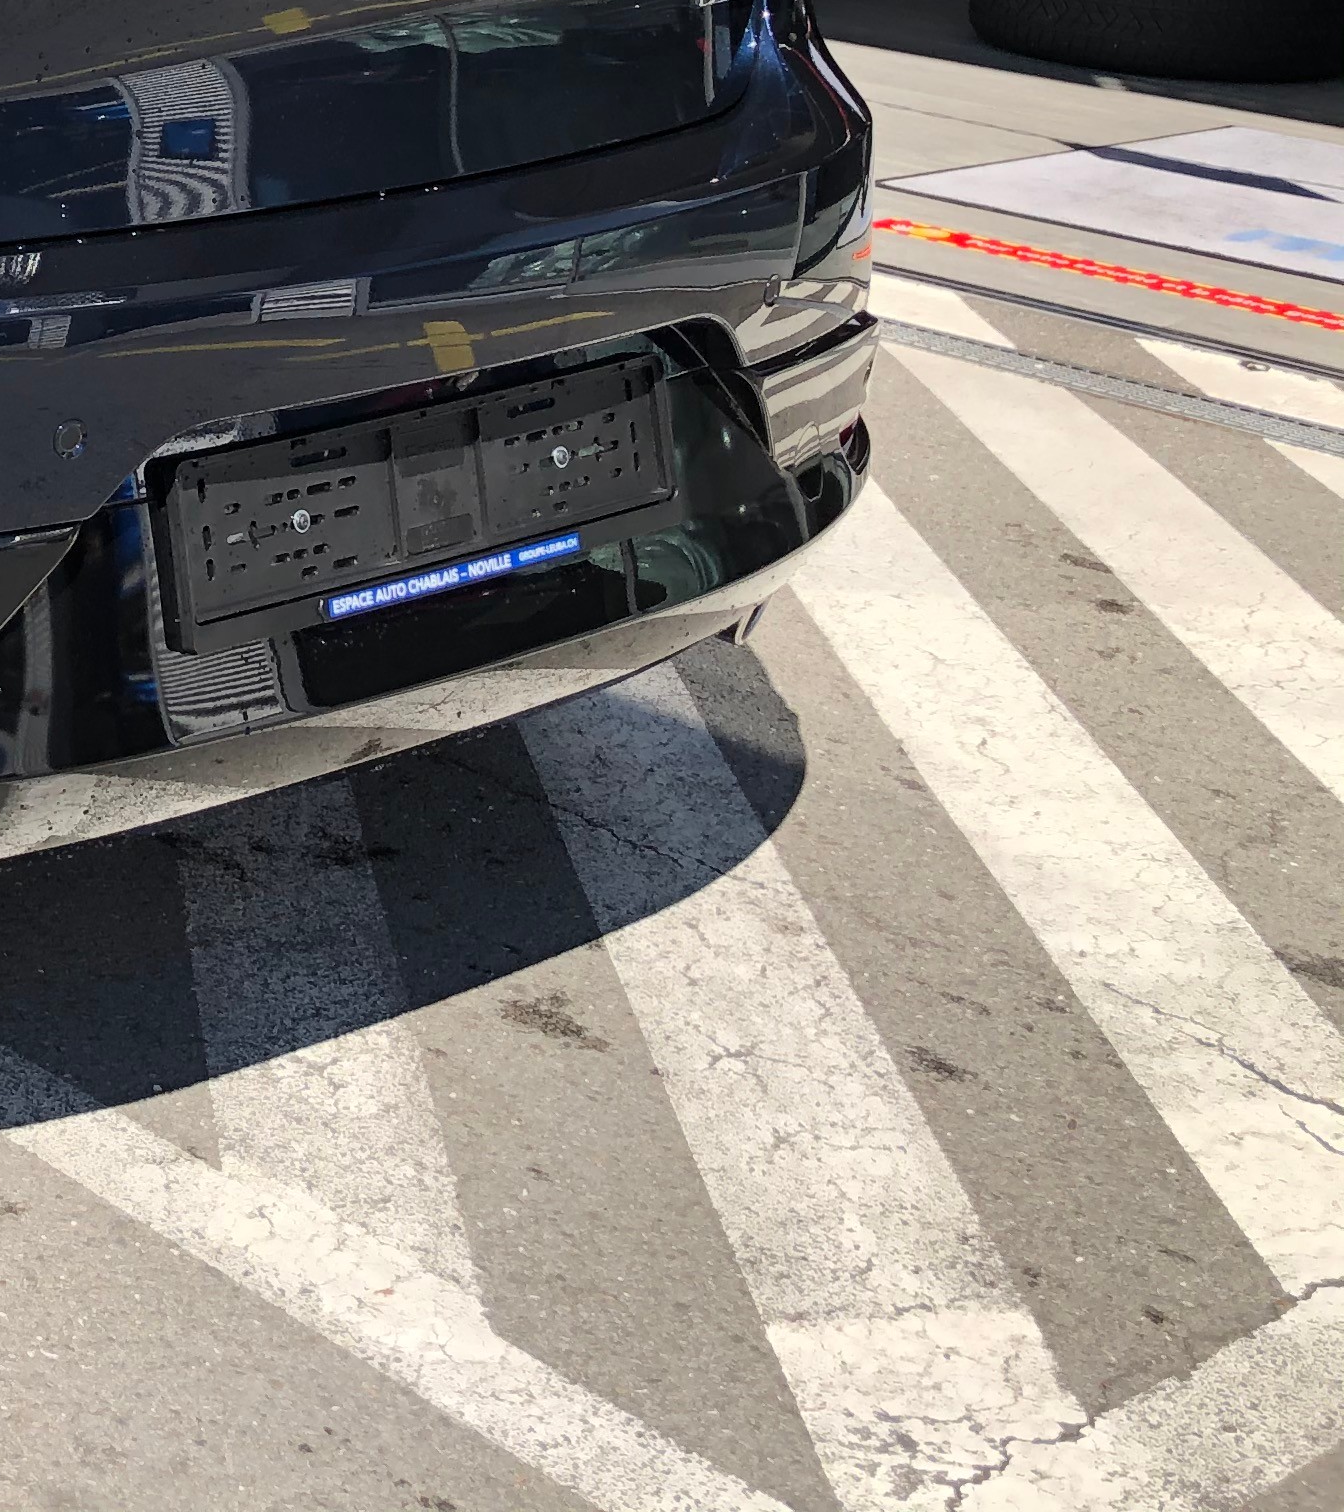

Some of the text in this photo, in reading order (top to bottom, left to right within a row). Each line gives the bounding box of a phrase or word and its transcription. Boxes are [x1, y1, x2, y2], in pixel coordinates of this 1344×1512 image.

[332, 592, 374, 615] ESPACE
[375, 582, 407, 603] AUTO
[408, 568, 460, 594] CHABLAIS
[468, 554, 512, 576] NOVILLE
